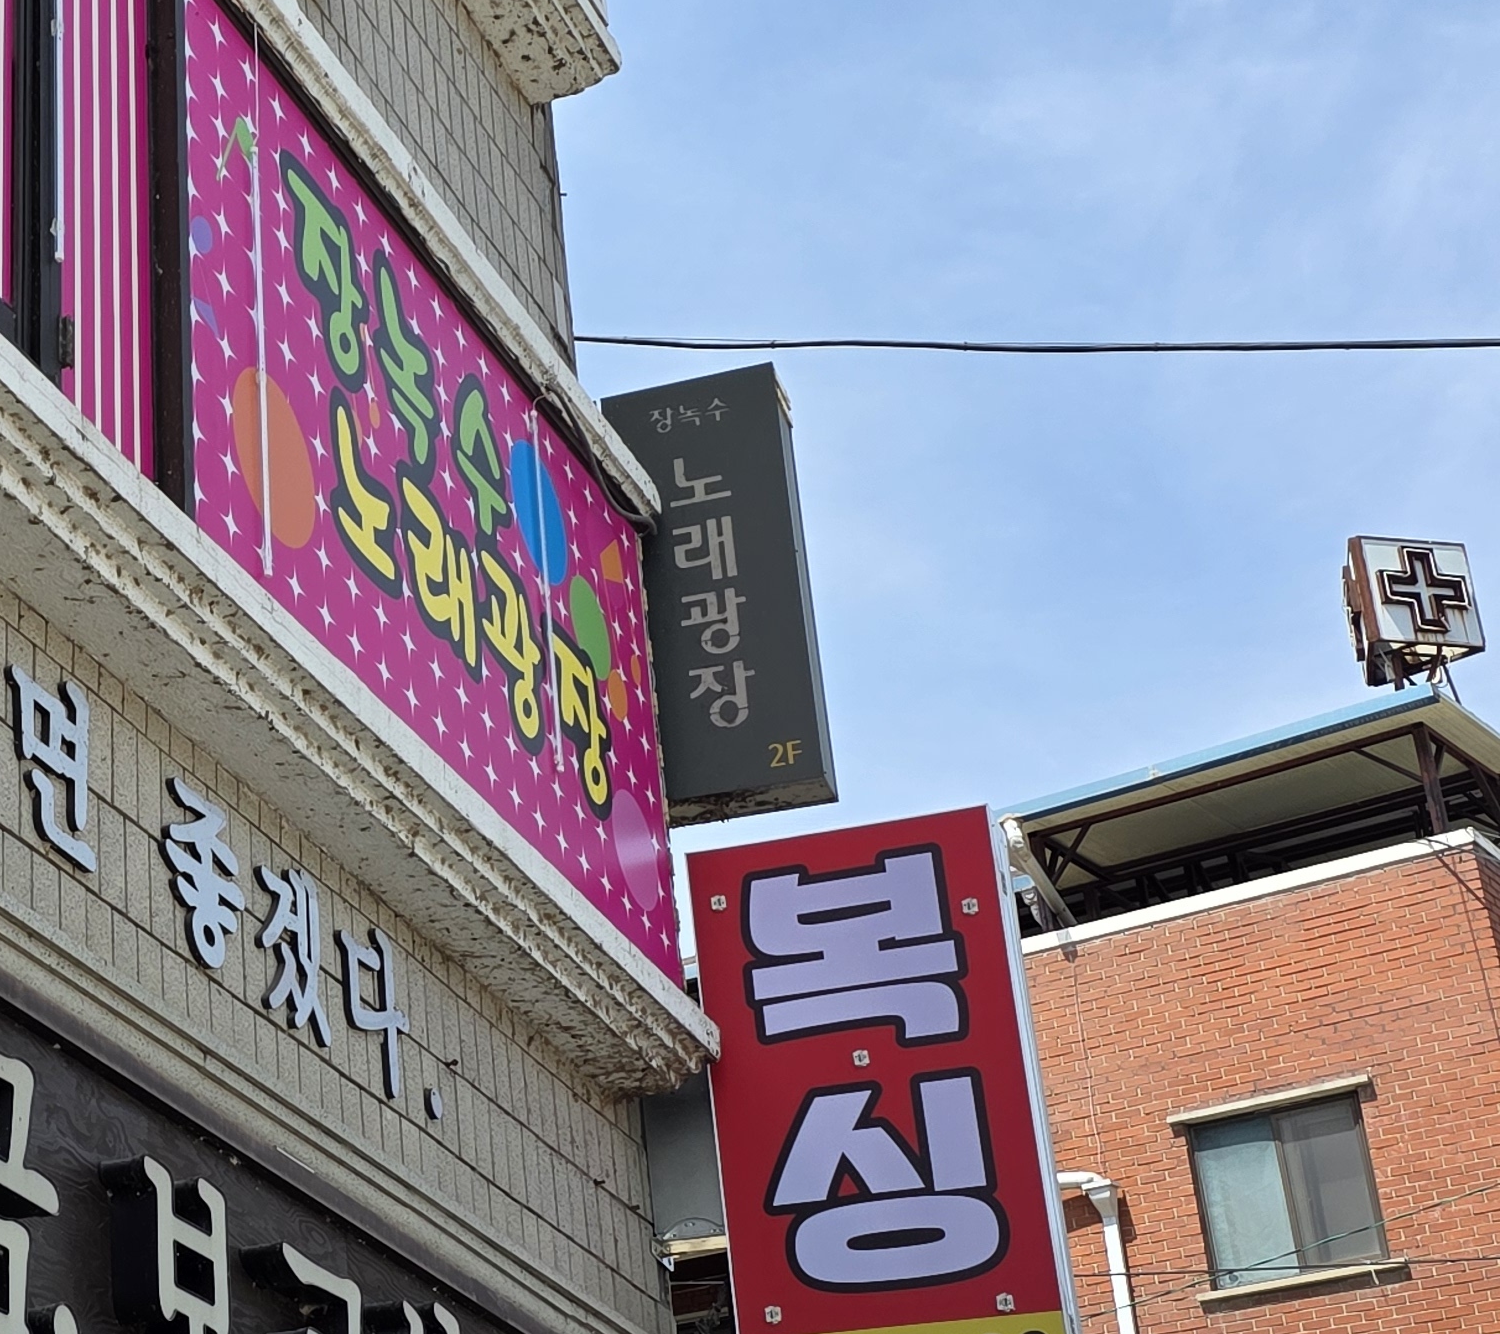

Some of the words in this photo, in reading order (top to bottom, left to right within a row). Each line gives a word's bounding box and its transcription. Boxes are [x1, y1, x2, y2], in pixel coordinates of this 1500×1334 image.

[284, 165, 510, 537] 장녹수
[649, 398, 729, 433] 장녹수
[335, 401, 608, 807] 노래광장
[670, 457, 756, 728] 노래광장
[767, 740, 803, 767] 2F
[162, 775, 444, 1121] 좋겠다.
[745, 849, 1003, 1287] 복싱
